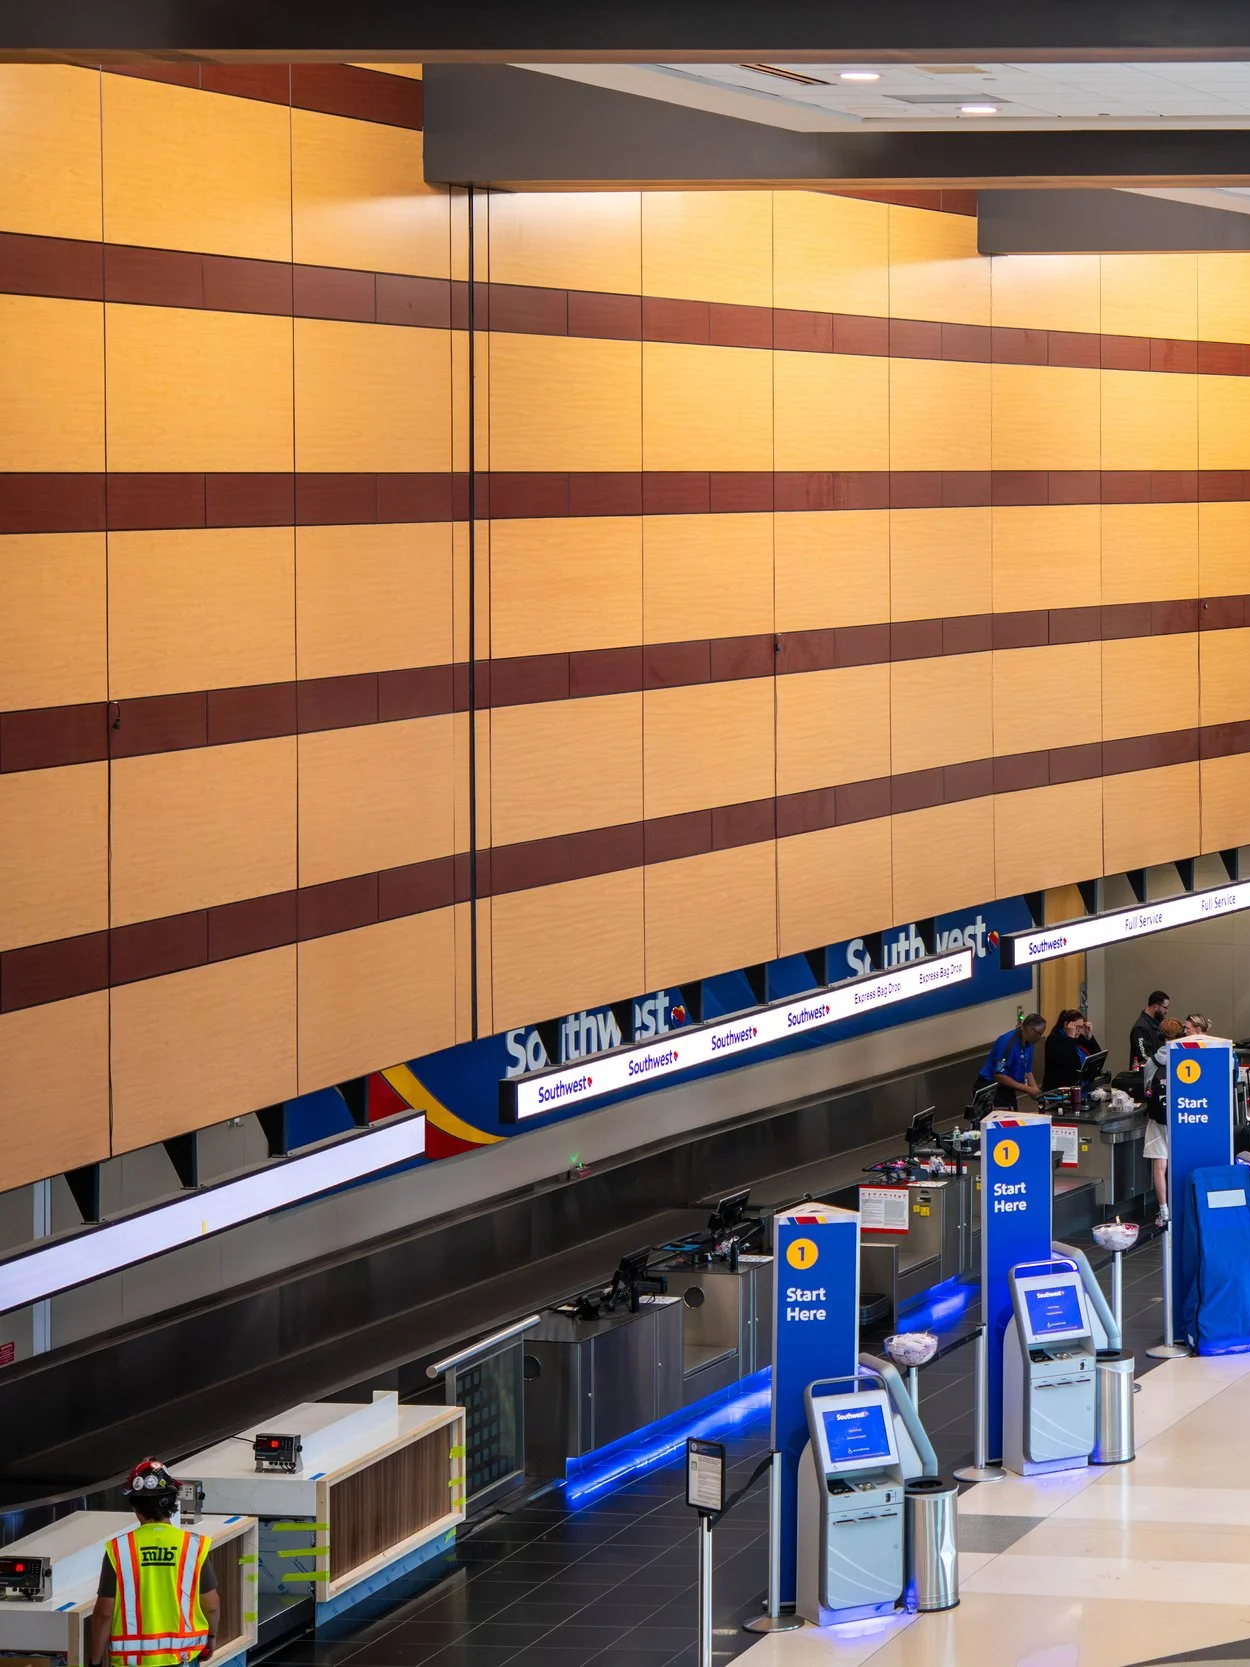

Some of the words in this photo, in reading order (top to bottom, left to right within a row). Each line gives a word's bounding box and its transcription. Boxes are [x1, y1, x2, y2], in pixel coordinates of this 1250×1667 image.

[1201, 897, 1213, 912] Full
[1214, 894, 1236, 909] Service
[1125, 916, 1138, 931] Full
[1139, 912, 1163, 928] Service
[1028, 936, 1063, 955] Southwest
[919, 970, 939, 985] Express
[939, 967, 950, 978] Bag
[950, 964, 963, 975] Drop
[854, 990, 876, 1004] Express
[876, 986, 888, 998] Bag
[888, 982, 902, 994] Drop
[787, 1004, 826, 1028] Southwest
[711, 1026, 753, 1051] Southwest
[628, 1050, 673, 1076] Southwest
[1185, 1066, 1191, 1077] 1
[538, 1075, 587, 1103] Southwest
[1177, 1097, 1208, 1109] Start
[1178, 1112, 1209, 1124] Here
[1003, 1147, 1009, 1160] 1
[993, 1182, 1027, 1196] Start
[994, 1200, 1027, 1214] Here
[797, 1246, 806, 1262] 1
[786, 1287, 827, 1302] Start
[786, 1307, 827, 1322] Here
[142, 1547, 175, 1562] mlb
